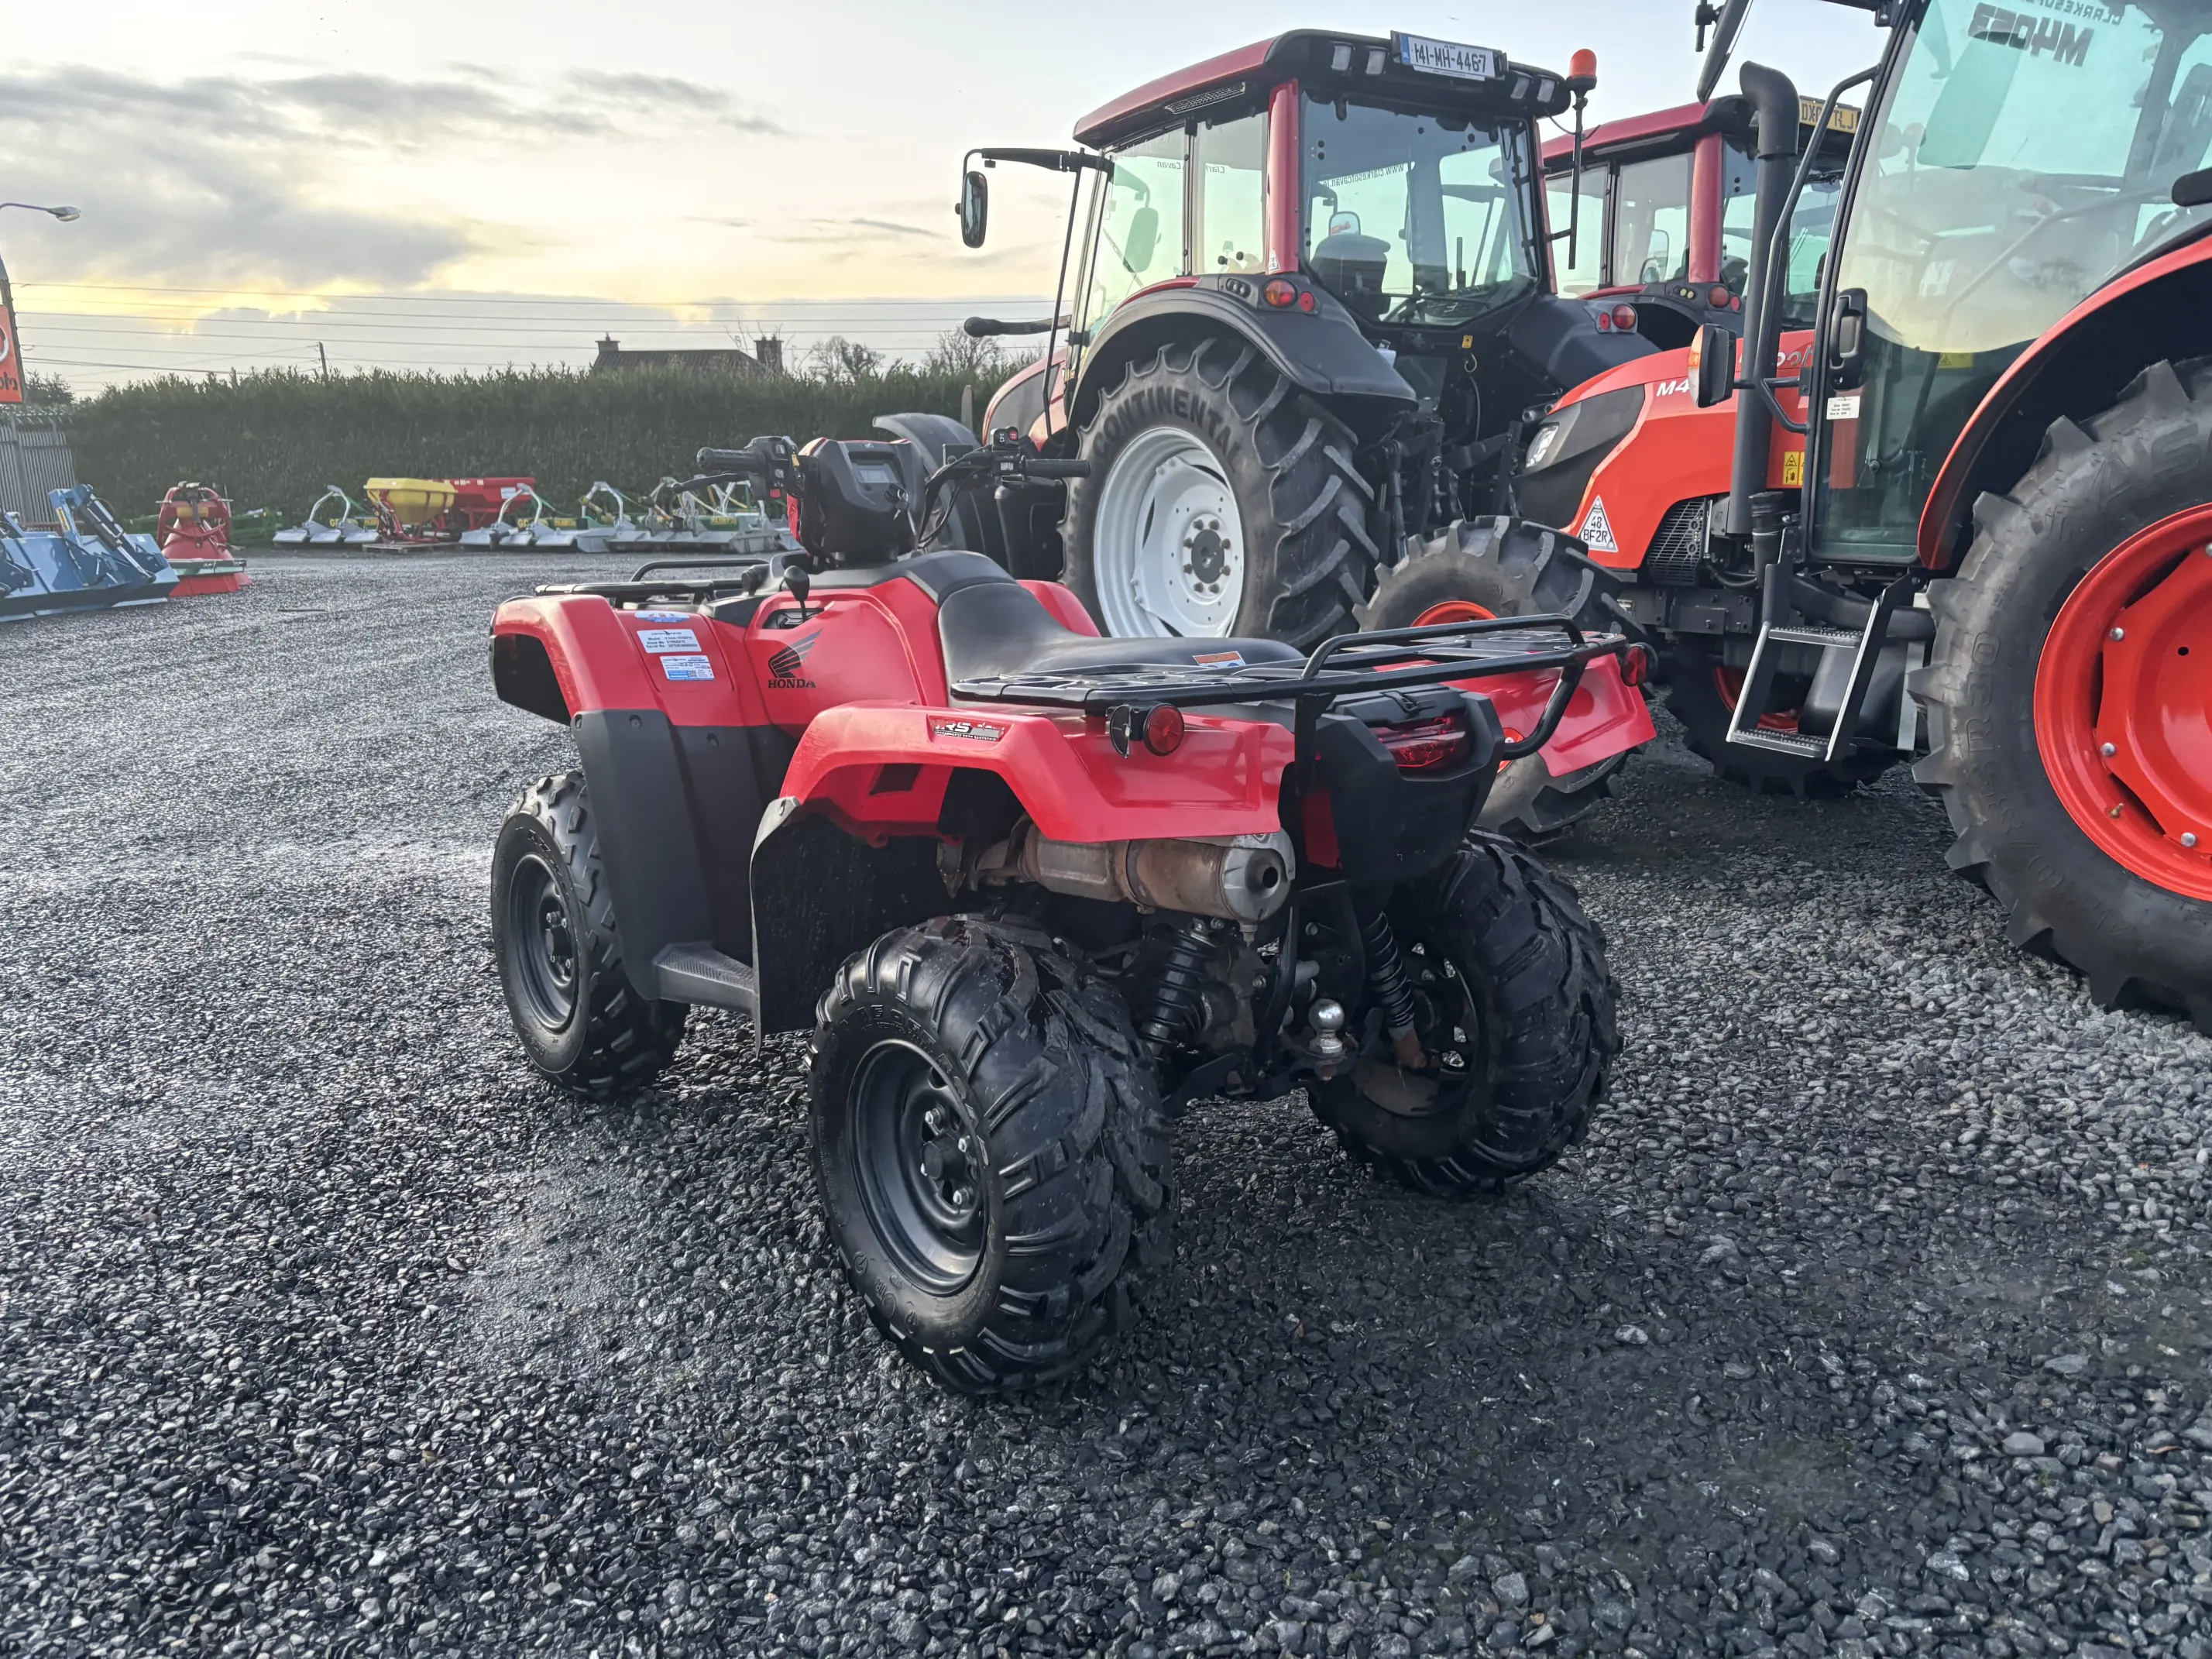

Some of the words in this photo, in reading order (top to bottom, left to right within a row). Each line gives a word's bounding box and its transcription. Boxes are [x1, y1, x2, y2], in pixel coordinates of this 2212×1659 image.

[1414, 43, 1486, 73] 141-MH-4467
[1591, 516, 1602, 529] 48
[1583, 529, 1608, 543] BF2R
[768, 678, 816, 689] HONDA
